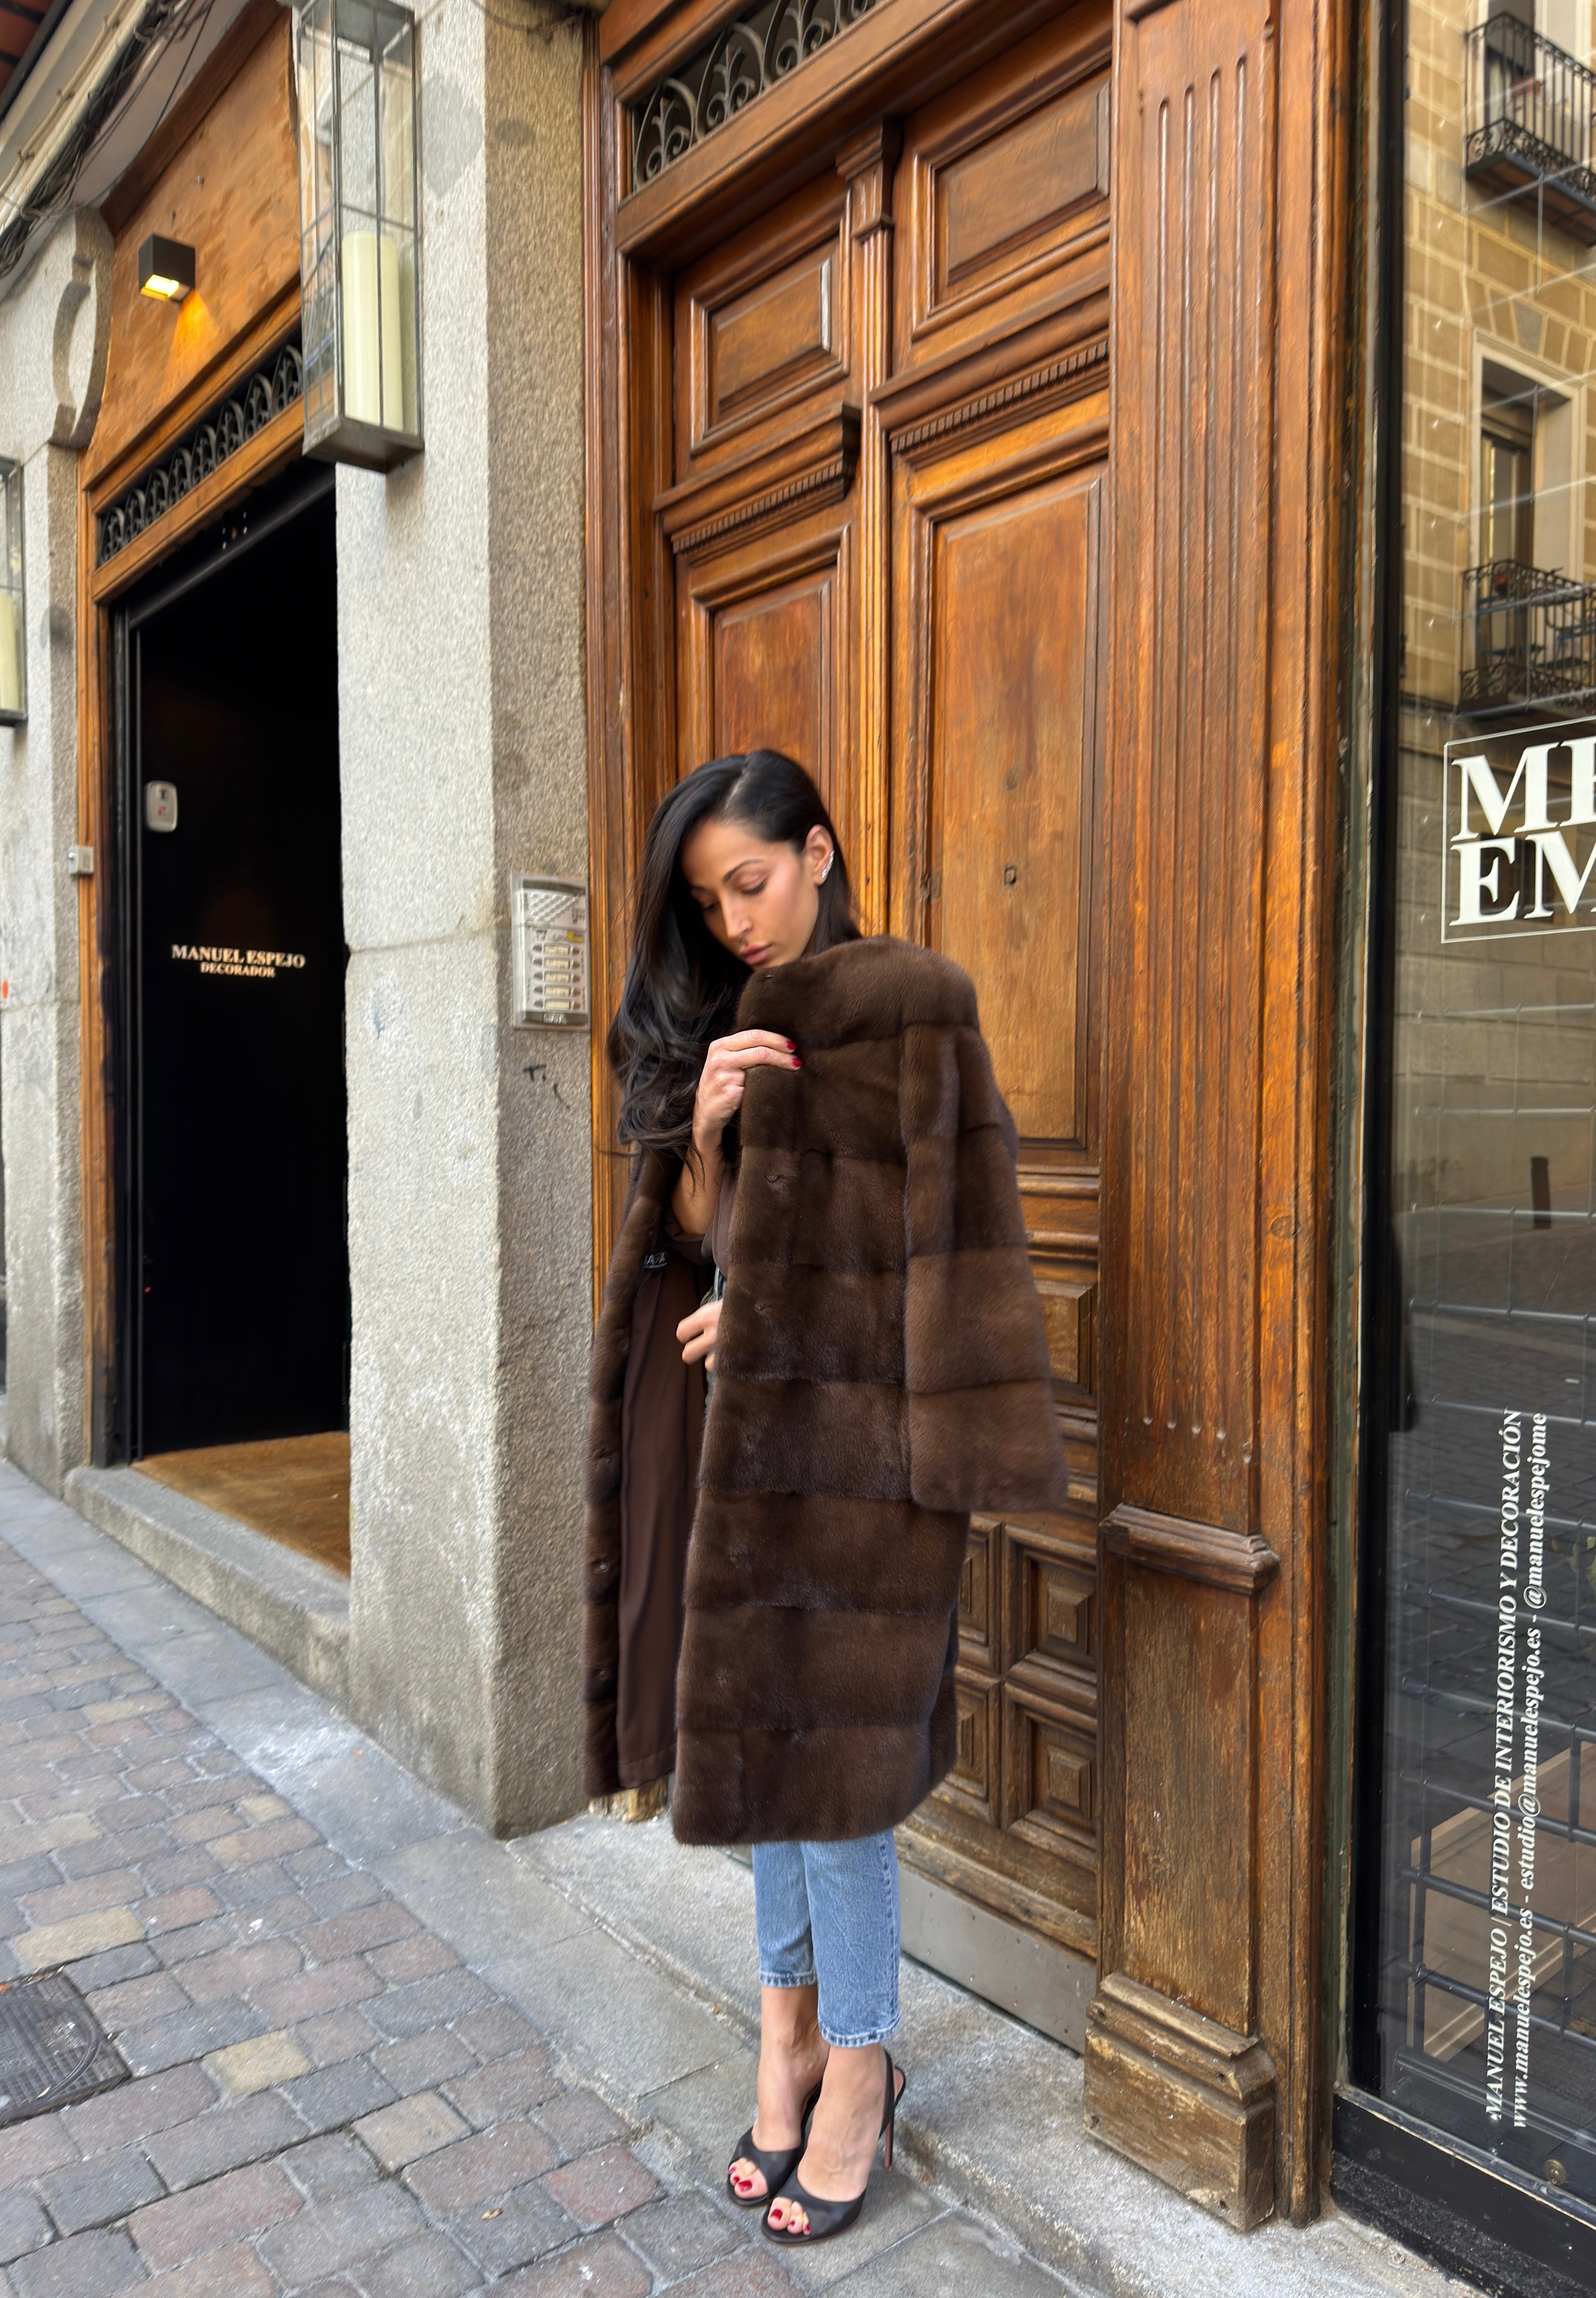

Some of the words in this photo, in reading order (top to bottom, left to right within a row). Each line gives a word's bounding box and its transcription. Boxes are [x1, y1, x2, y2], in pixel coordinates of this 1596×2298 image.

[171, 944, 244, 963] MANUEL
[246, 949, 306, 969] ESPEJO
[200, 962, 276, 978] DECORADOR
[1498, 1409, 1522, 1570] DECORACIÓN
[1523, 1413, 1550, 1609] @manuelespejome
[1499, 1571, 1517, 1589] Y
[1495, 1595, 1517, 1773] INTERIORISMO
[1494, 1775, 1512, 1809] DE
[1517, 1628, 1544, 1890] estudio@manuelespejo.es
[1491, 1812, 1511, 1915] ESTUDIO
[1488, 1928, 1508, 2016] ESPEJO
[1513, 1909, 1537, 2128] www.manuelespejo.es
[1486, 2019, 1505, 2120] MANUEL
